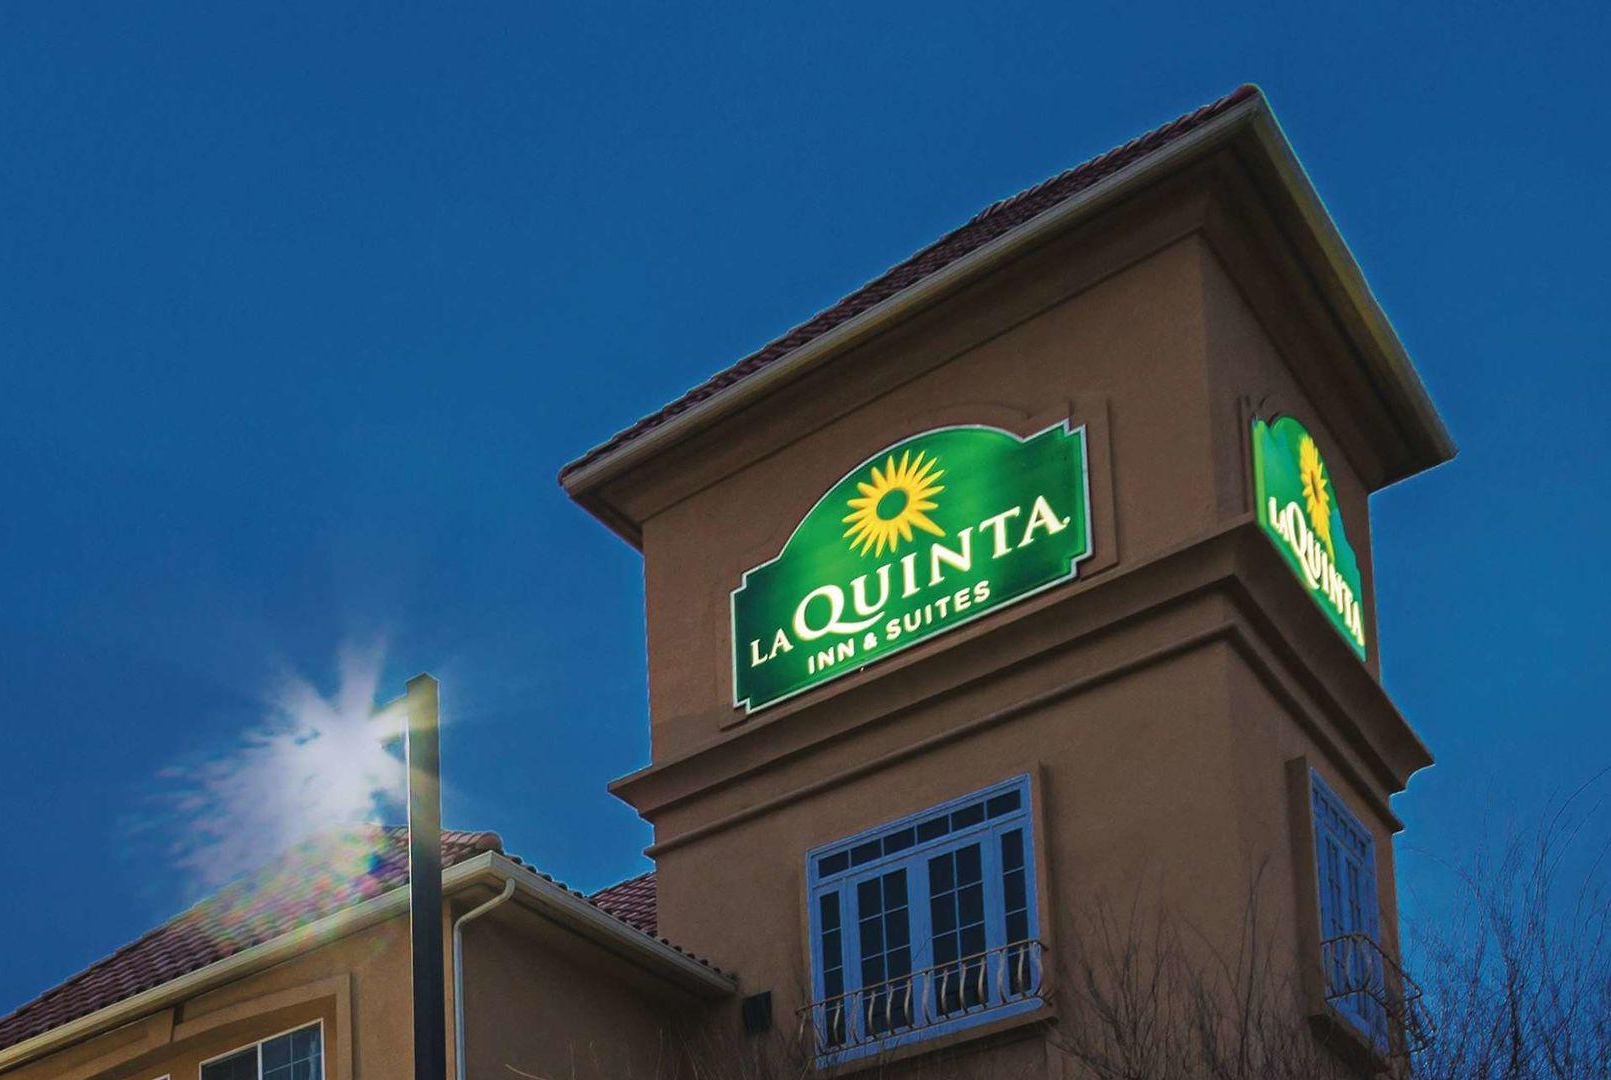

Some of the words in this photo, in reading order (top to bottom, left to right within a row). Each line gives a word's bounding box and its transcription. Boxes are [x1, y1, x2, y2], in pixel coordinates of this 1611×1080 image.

[750, 628, 794, 668] LA
[792, 495, 1071, 642] QUINTA
[807, 637, 855, 675] INN
[863, 631, 879, 651] &
[886, 580, 991, 641] SUITES
[1268, 496, 1291, 542] LA
[1286, 501, 1365, 647] QUINTA
